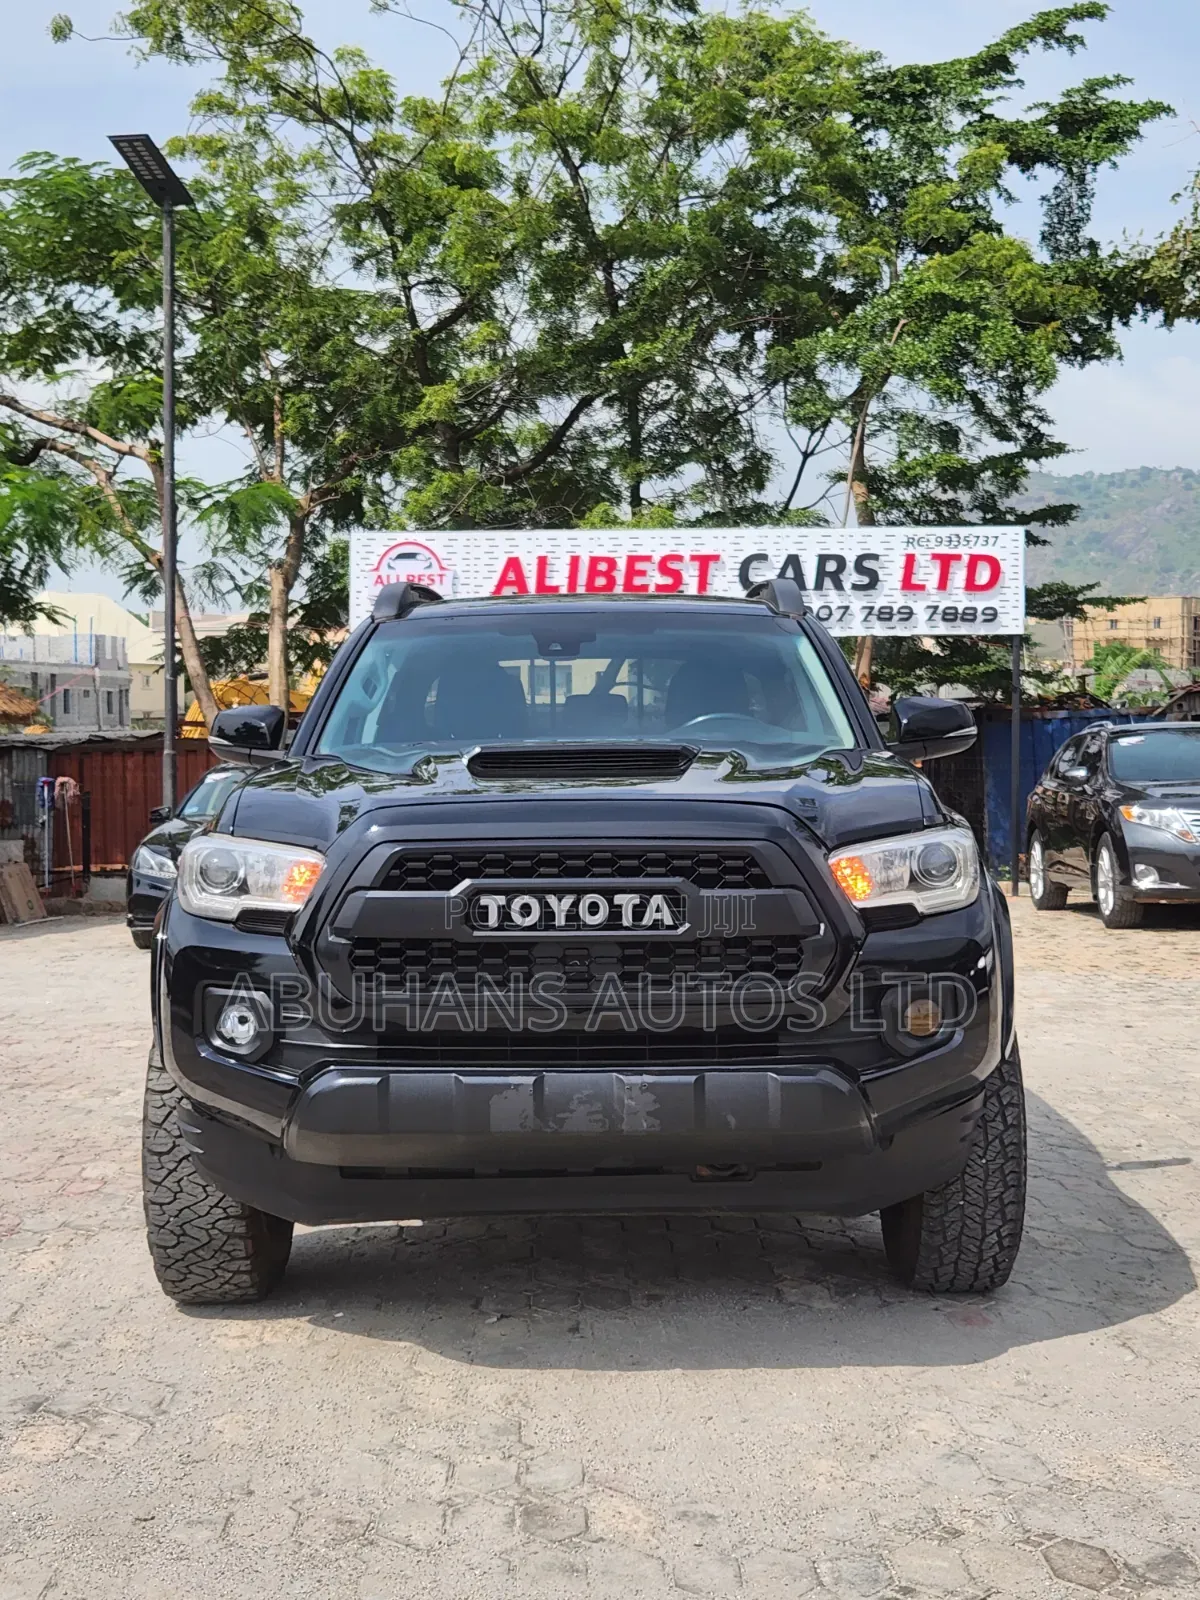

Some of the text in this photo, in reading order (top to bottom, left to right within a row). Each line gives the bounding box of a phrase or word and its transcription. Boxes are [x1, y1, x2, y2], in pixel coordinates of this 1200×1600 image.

[934, 535, 999, 548] 9335737
[492, 552, 1001, 595] ALIBEST CARS LTD
[860, 605, 914, 622] 789
[925, 605, 999, 623] 7889
[479, 894, 676, 928] TOYOTA
